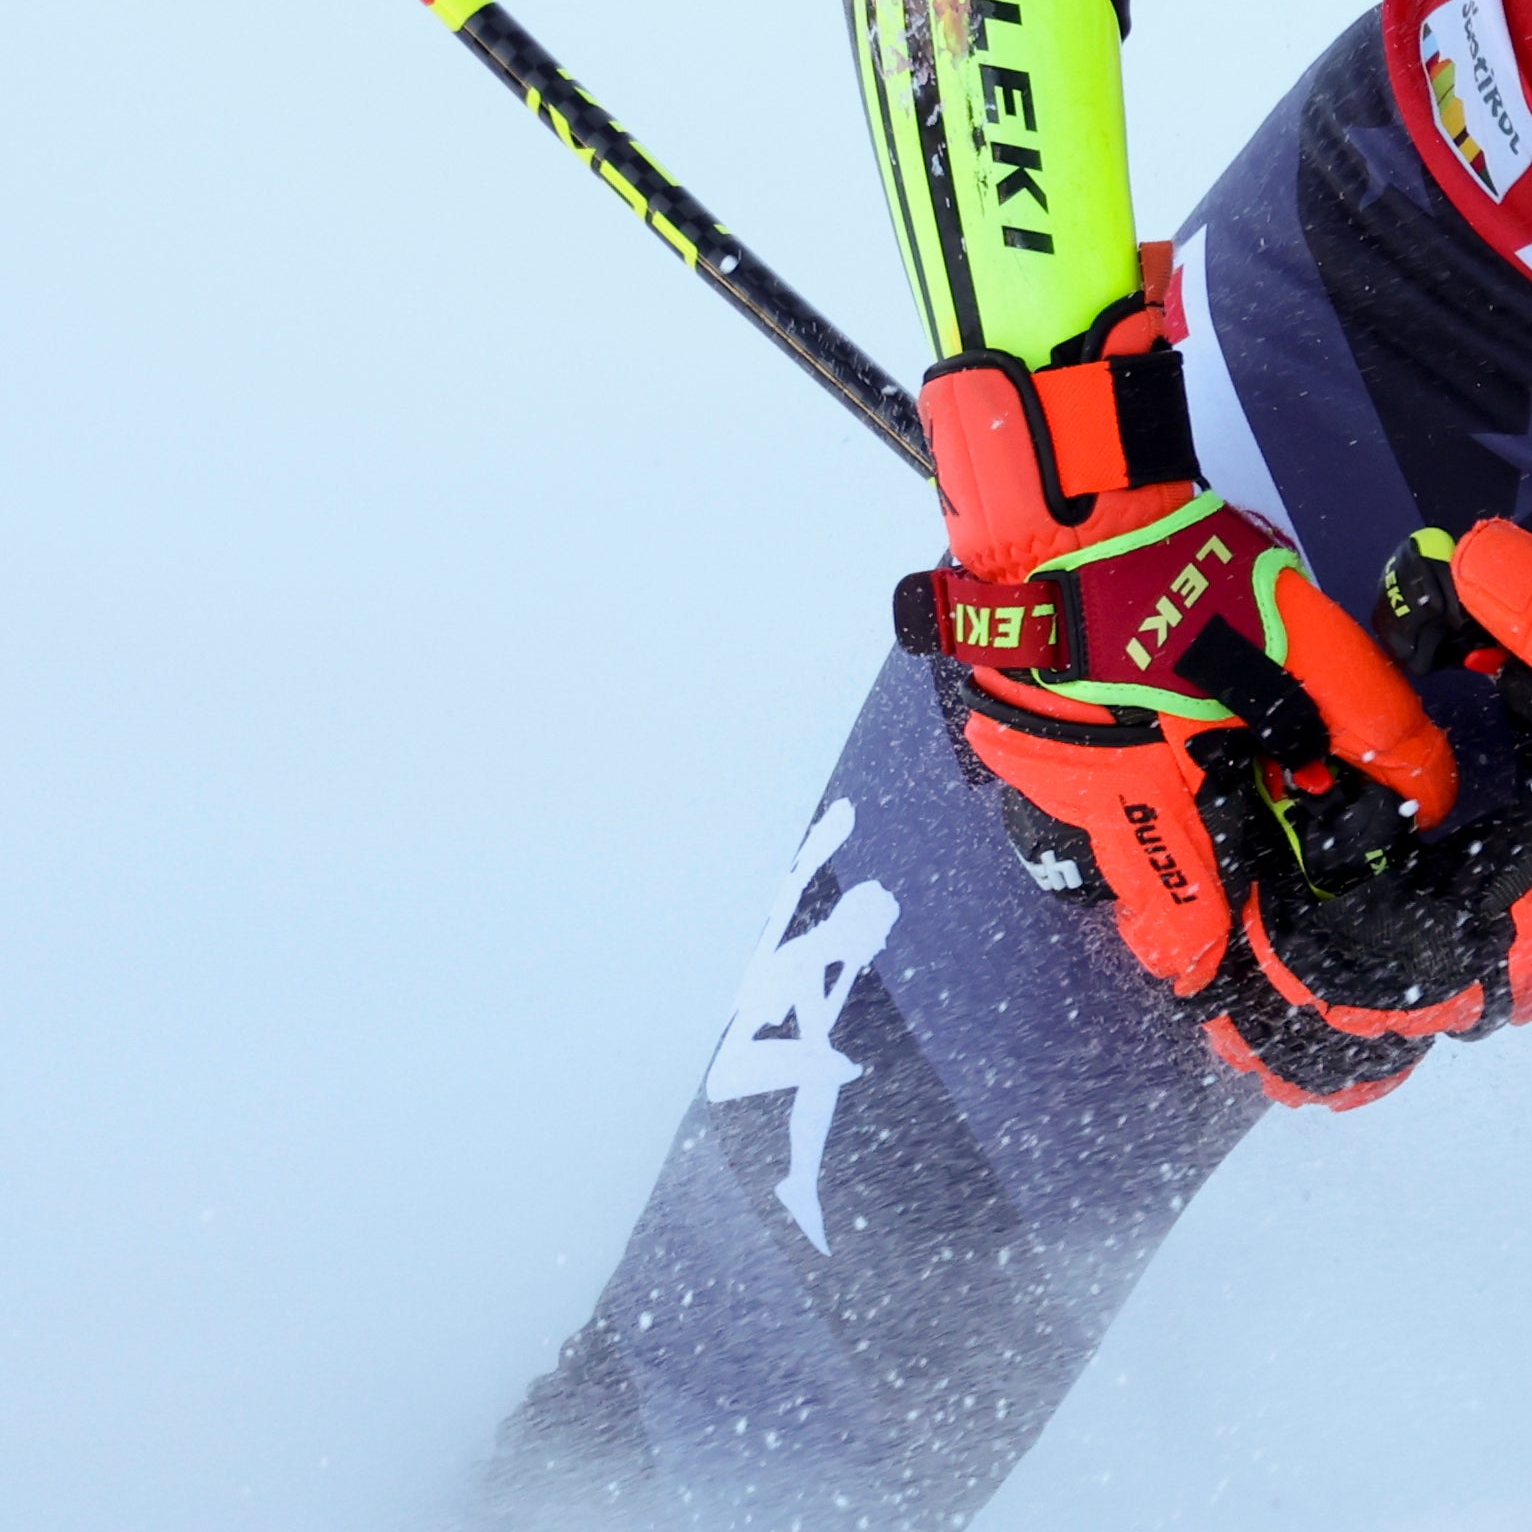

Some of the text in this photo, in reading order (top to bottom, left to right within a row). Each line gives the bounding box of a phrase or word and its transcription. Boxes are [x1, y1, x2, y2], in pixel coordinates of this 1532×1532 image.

[955, 602, 1058, 649] LEKI
[1125, 534, 1234, 672] LEKI
[1384, 555, 1411, 618] LEKI
[1124, 803, 1198, 905] racing
